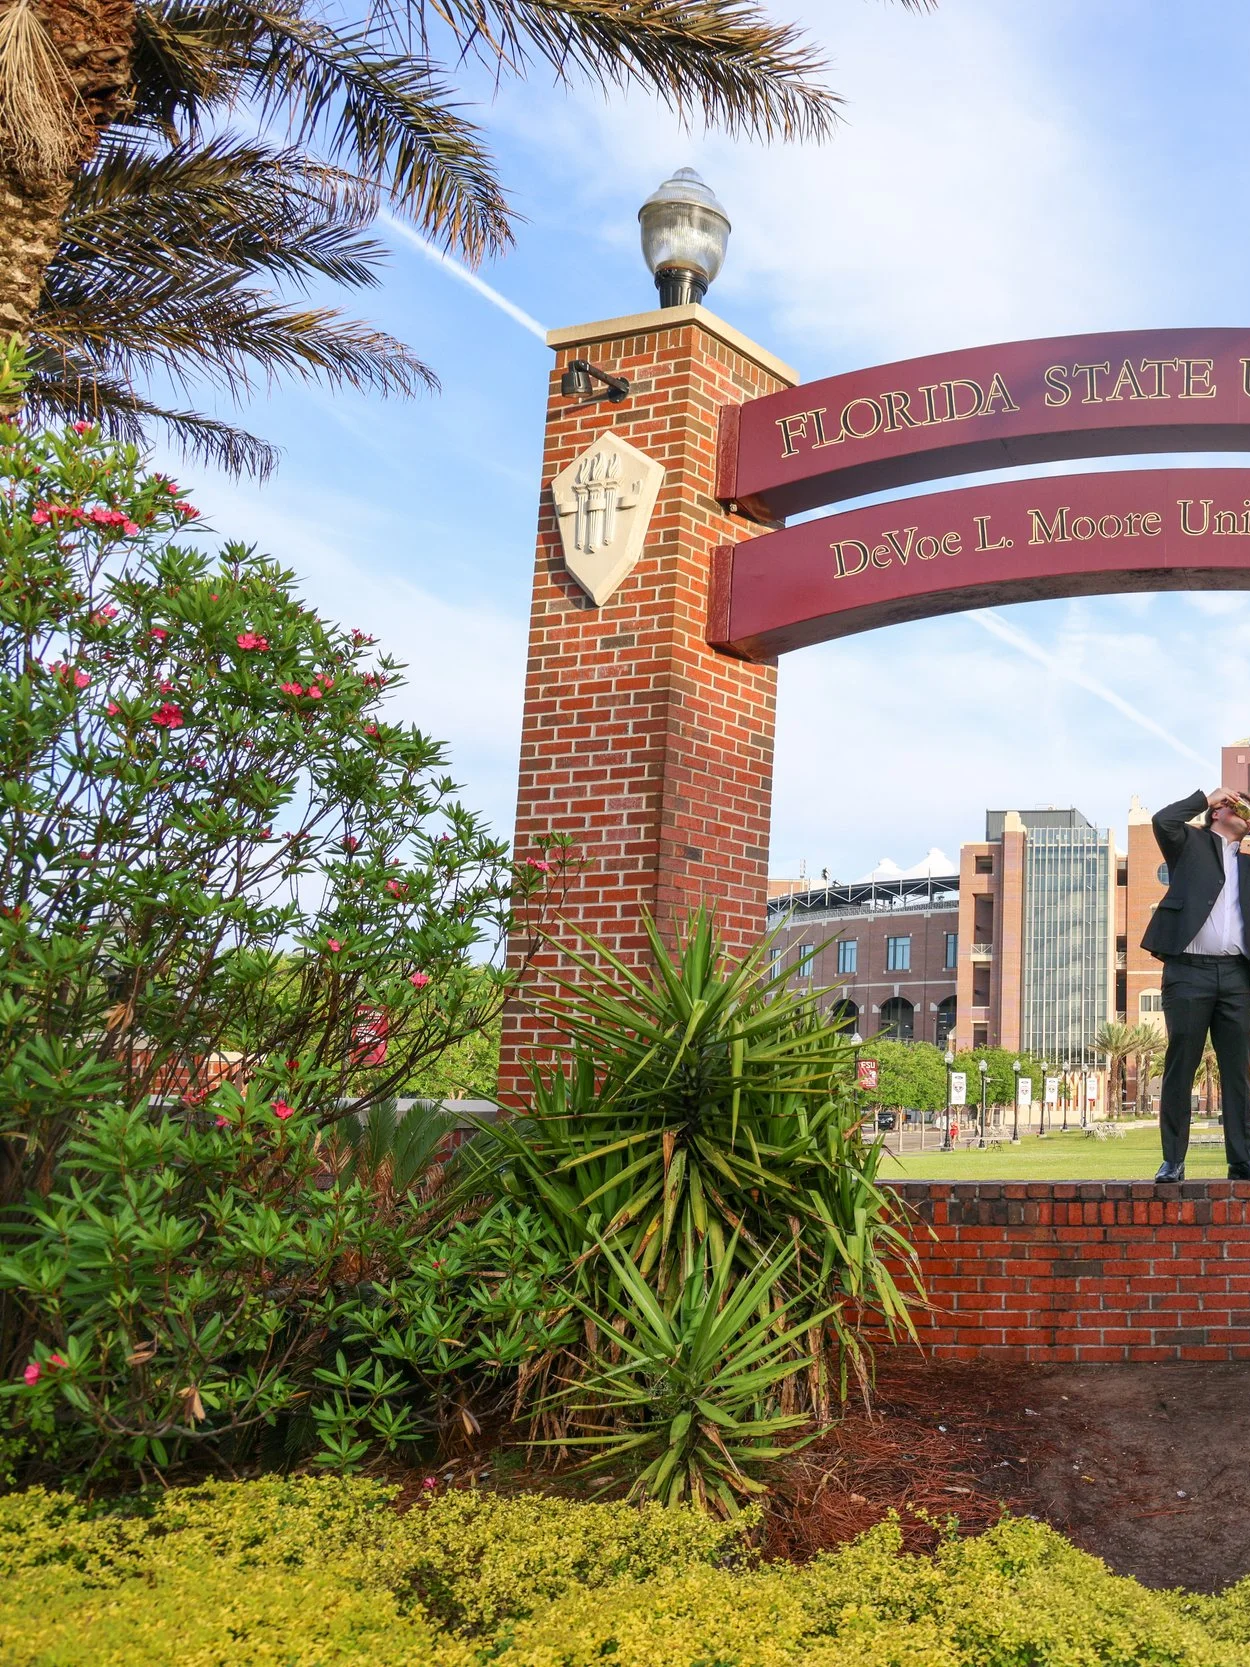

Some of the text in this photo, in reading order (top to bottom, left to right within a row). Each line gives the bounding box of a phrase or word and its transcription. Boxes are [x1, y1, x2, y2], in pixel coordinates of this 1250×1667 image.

[774, 373, 1020, 459] FLORIDA
[1043, 357, 1217, 407] STATE
[830, 527, 963, 580] DeVoe
[974, 515, 1015, 552] L.
[1028, 506, 1162, 546] Moore
[860, 1061, 876, 1069] FSU
